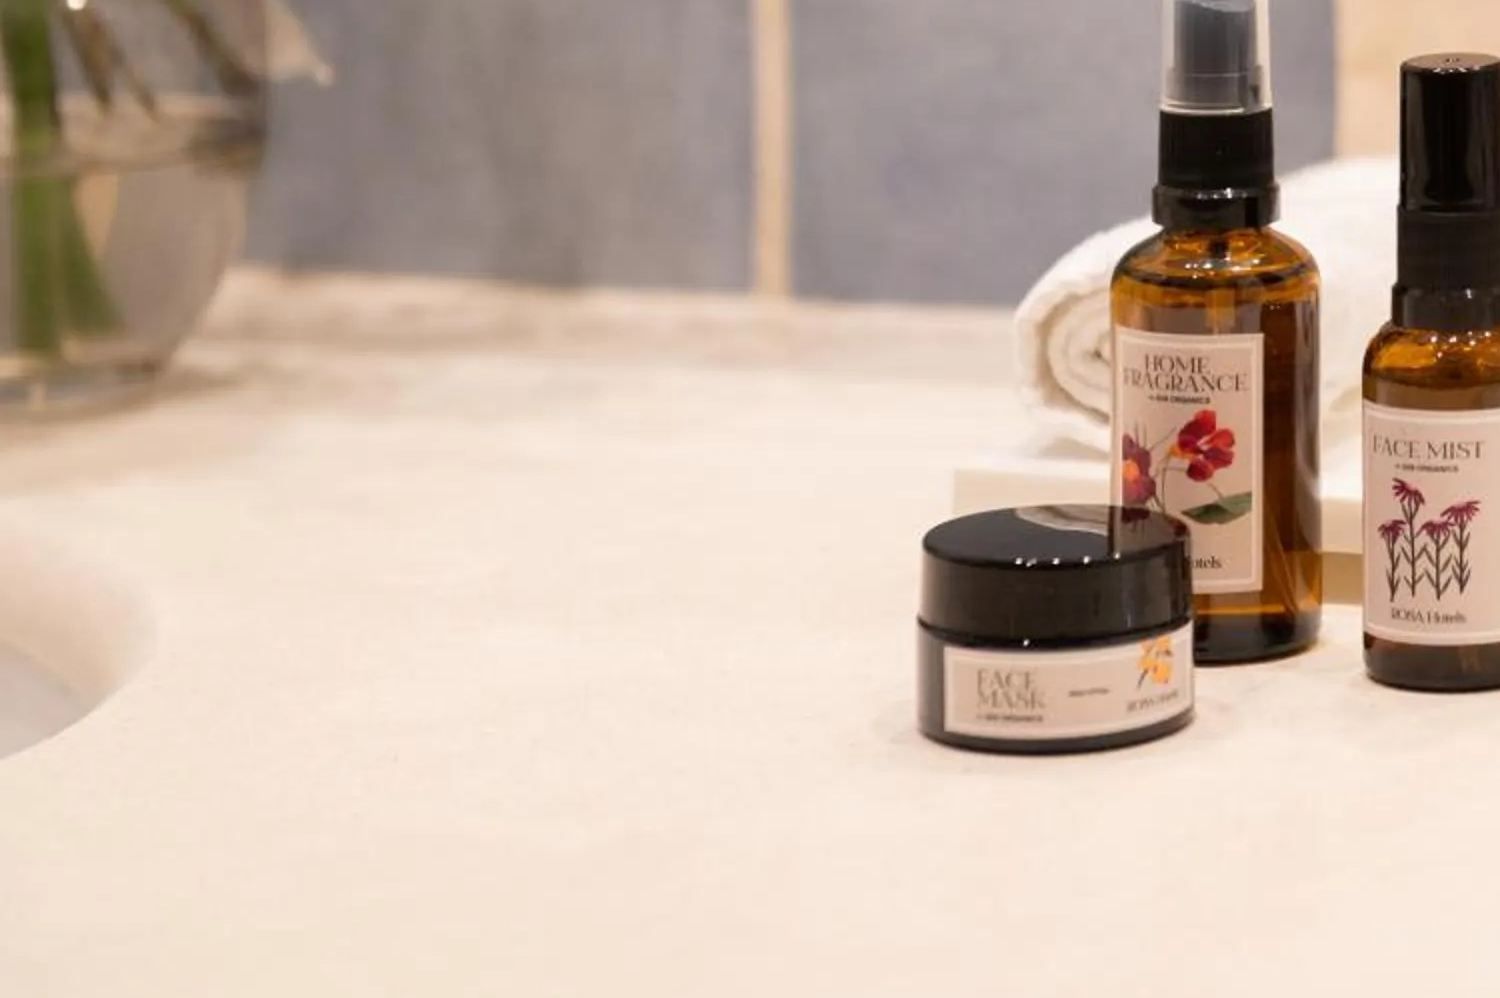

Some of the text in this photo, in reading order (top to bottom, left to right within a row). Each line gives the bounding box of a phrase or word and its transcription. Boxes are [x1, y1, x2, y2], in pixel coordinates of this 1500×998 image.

[1145, 354, 1211, 374] HOME
[1123, 367, 1250, 393] FRAGRANCE
[1372, 434, 1485, 460] FACE MIST
[1191, 556, 1223, 570] otels
[977, 668, 1038, 690] FACE
[977, 689, 1047, 711] MASK
